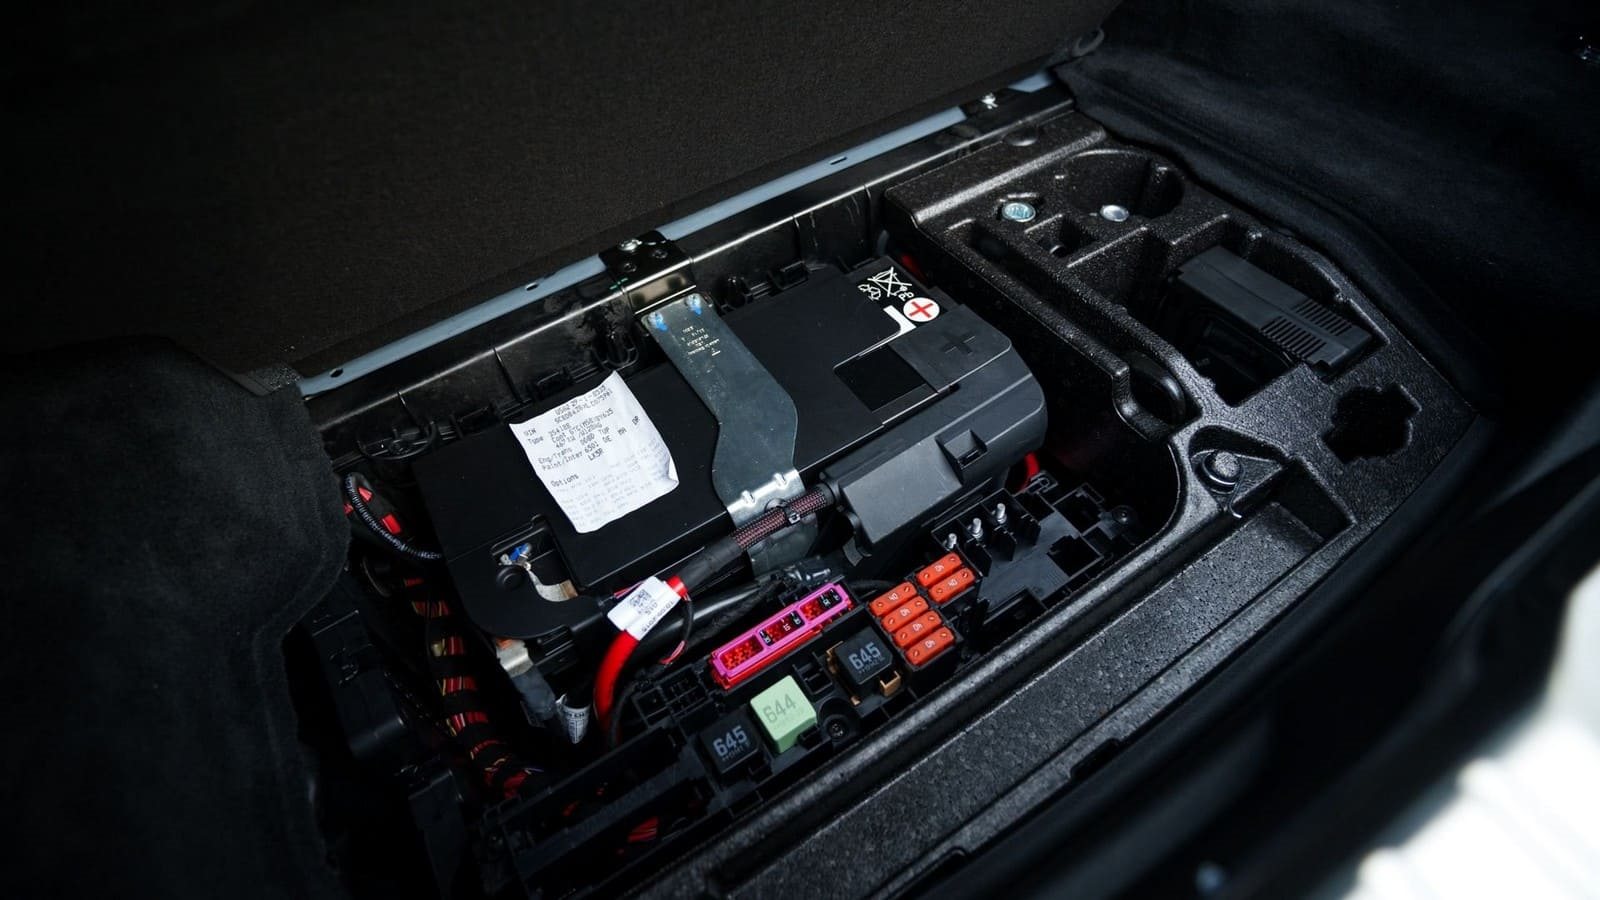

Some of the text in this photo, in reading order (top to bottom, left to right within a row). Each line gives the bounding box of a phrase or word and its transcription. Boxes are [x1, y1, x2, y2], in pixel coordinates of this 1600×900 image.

[898, 291, 914, 301] Pb
[889, 592, 899, 600] 40
[849, 641, 881, 670] 645
[763, 693, 797, 724] 644
[713, 725, 748, 757] 645
